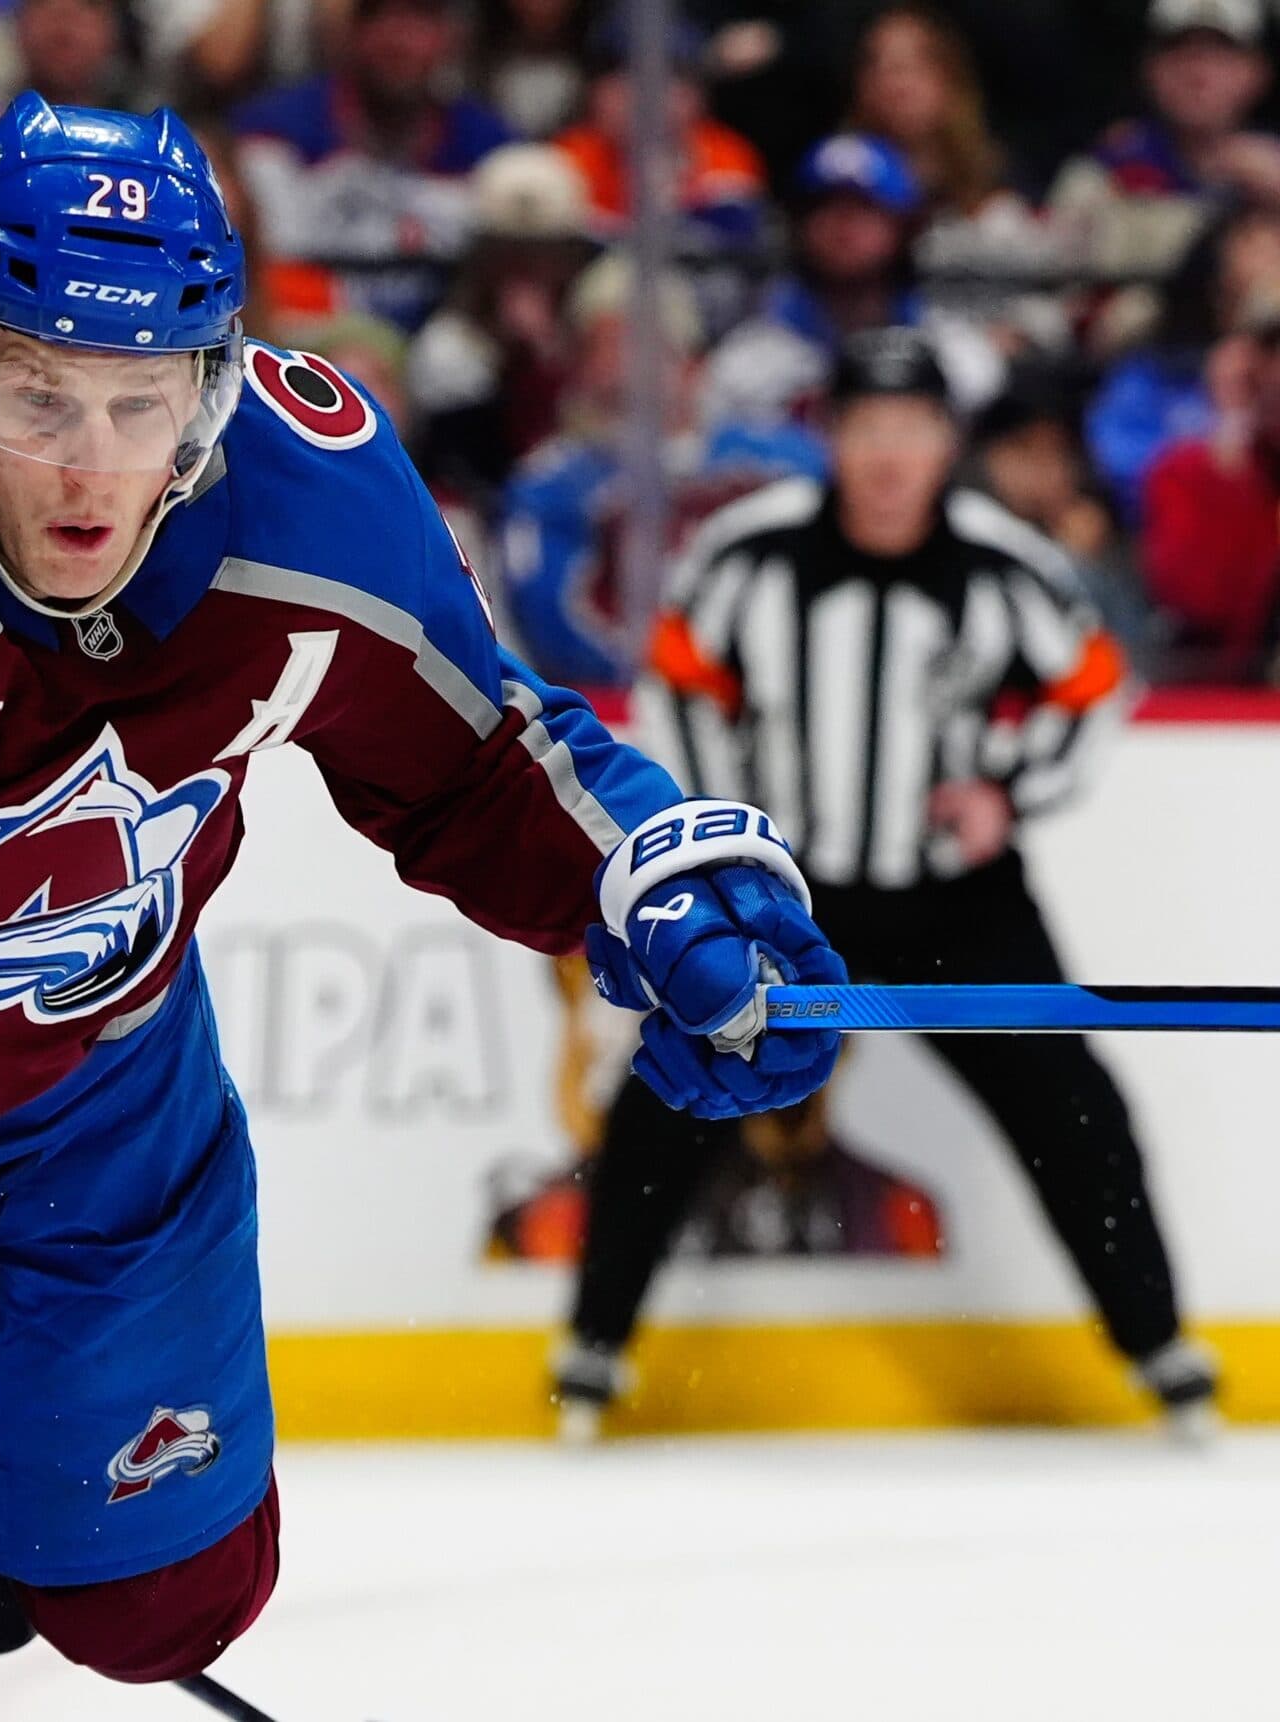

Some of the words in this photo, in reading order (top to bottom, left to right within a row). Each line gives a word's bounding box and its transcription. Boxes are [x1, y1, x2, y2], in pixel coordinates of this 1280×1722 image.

[84, 173, 148, 221] 29
[63, 280, 158, 307] CCM
[87, 622, 108, 650] NHL
[212, 629, 340, 763] A
[221, 924, 508, 1118] IPA
